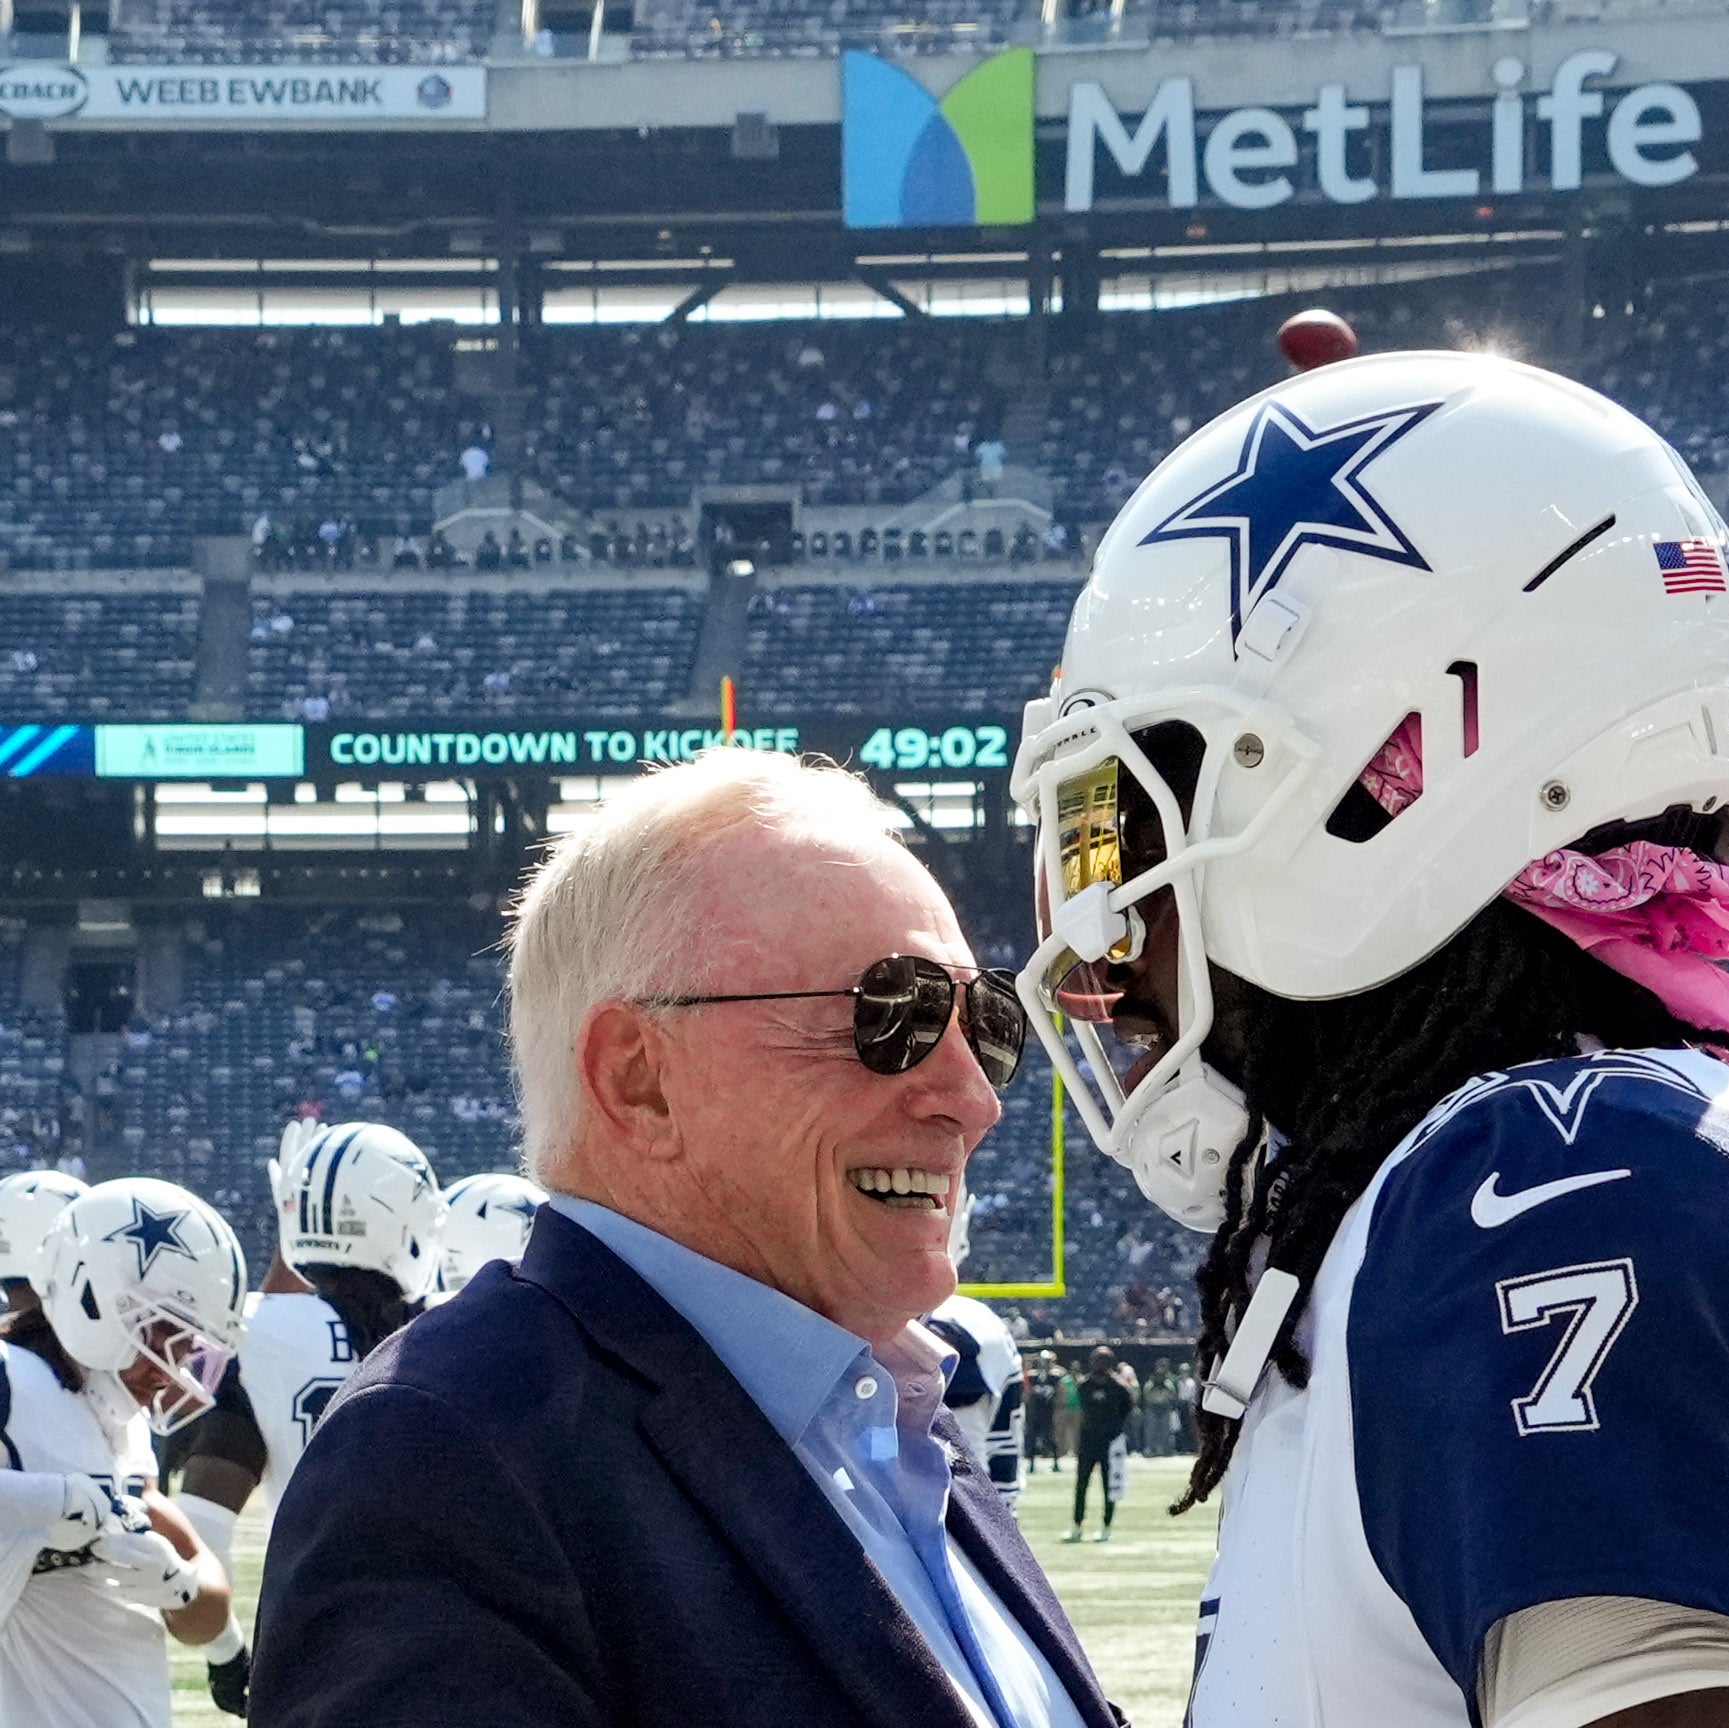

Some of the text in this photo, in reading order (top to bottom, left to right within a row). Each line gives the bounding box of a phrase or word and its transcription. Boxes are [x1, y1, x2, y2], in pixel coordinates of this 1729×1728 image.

[116, 77, 382, 106] WEEB EWBANK
[1065, 49, 1702, 212] MetLife
[330, 731, 577, 765] COUNTDOWN
[586, 730, 635, 763] TO
[860, 726, 1008, 769] 49:02
[1496, 1257, 1640, 1437] 7
